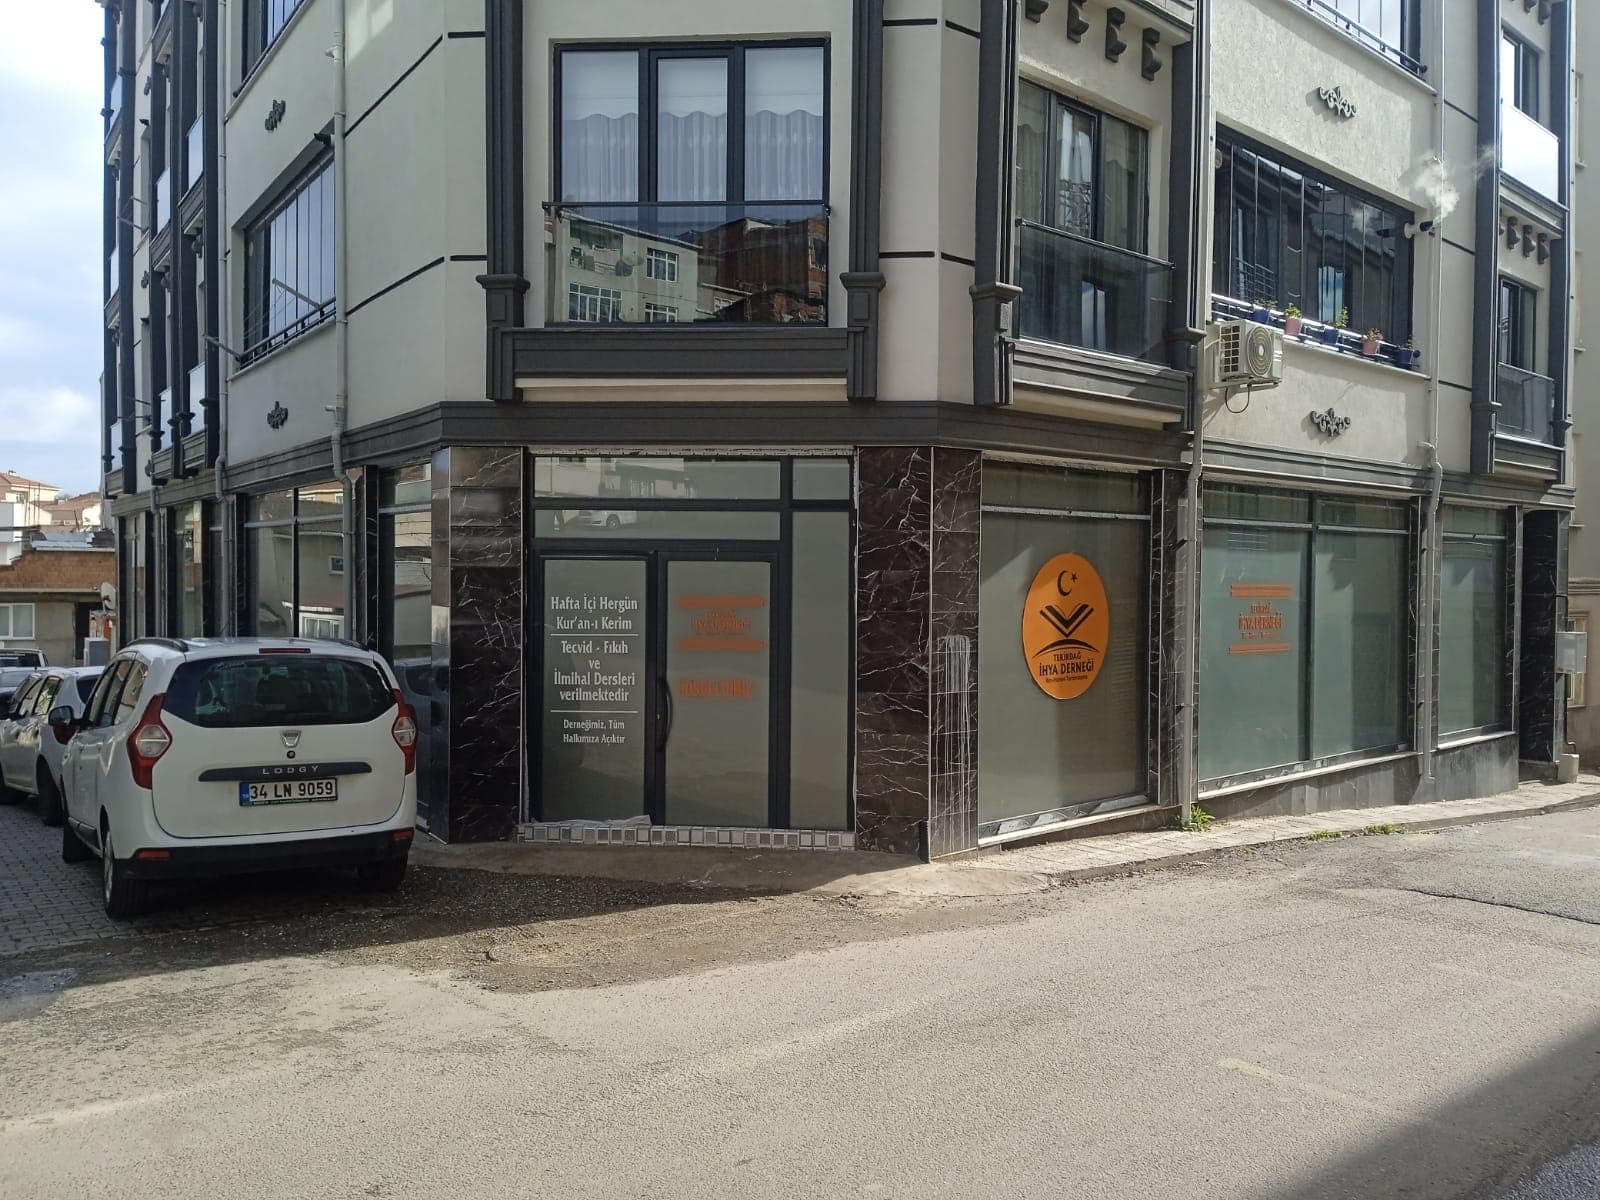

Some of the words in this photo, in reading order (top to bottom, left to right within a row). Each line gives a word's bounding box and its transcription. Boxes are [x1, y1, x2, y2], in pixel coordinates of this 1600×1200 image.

[551, 596, 580, 610] Hafta
[583, 592, 596, 613] İçi
[600, 596, 638, 613] Hergün
[556, 616, 598, 630] Kur'an-ı
[601, 616, 632, 630] Kerim
[561, 640, 593, 654] Tecvid
[604, 640, 629, 654] Fıkıh
[588, 659, 601, 670] ve
[1039, 662, 1058, 677] İHYA
[1060, 657, 1095, 674] DERNEĞİ
[554, 667, 591, 685] İlmihal
[594, 671, 635, 686] Dersleri
[560, 687, 629, 702] verilmektedir
[609, 719, 625, 729] Tüm
[563, 733, 600, 744] Halkımıza
[601, 733, 626, 746] Açıktır
[262, 765, 319, 775] LODGY
[250, 785, 267, 799] 34
[274, 783, 292, 798] LN
[298, 781, 333, 797] 9059
